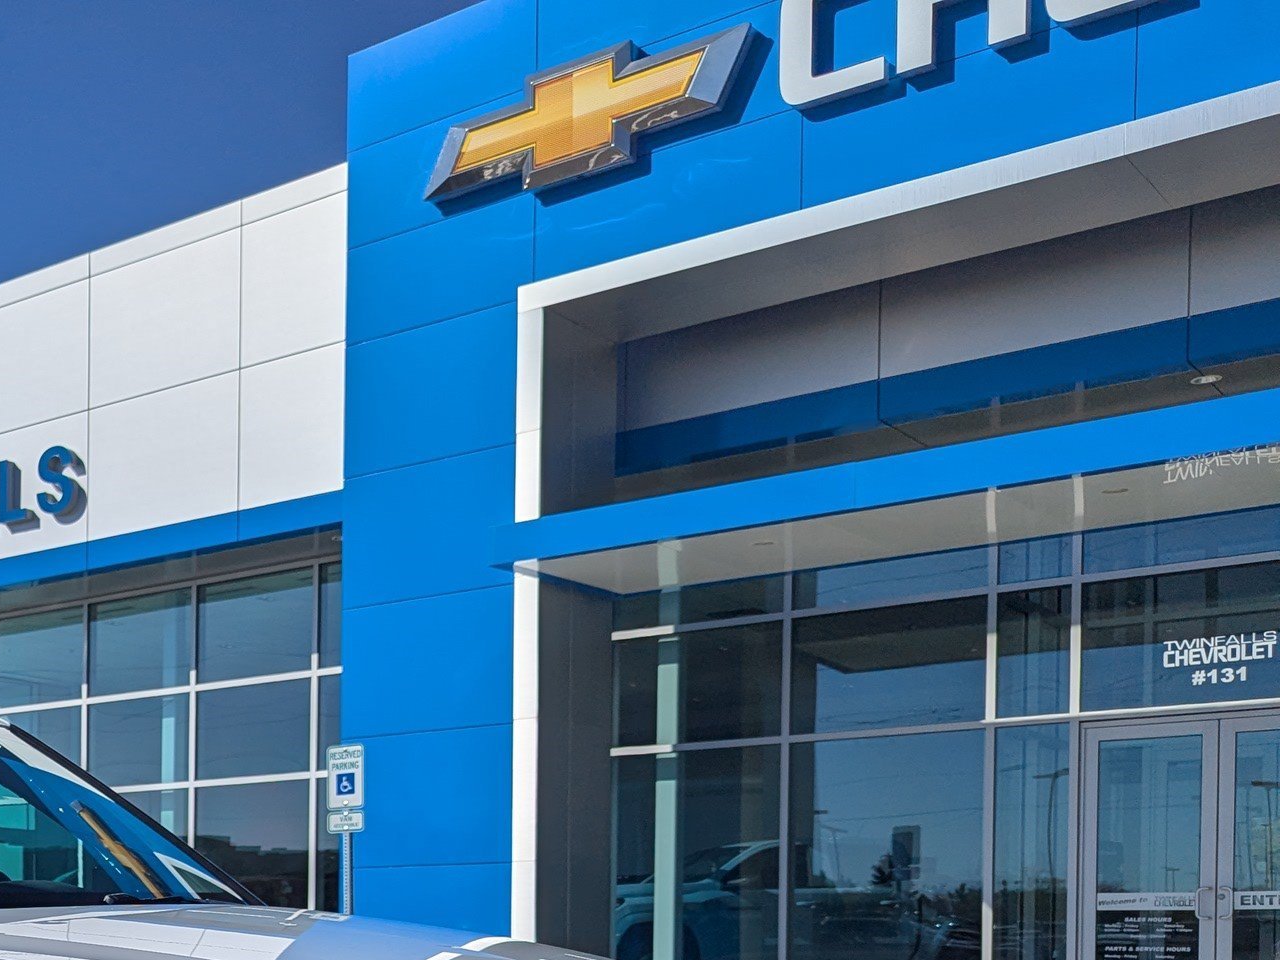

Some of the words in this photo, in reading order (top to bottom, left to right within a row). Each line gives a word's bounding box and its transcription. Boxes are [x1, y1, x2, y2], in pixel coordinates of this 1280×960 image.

[1163, 641, 1277, 668] CHEVROLET
[1191, 666, 1247, 686] #131
[329, 749, 361, 761] RESERVED
[331, 761, 360, 771] PARKING
[1098, 897, 1137, 906] Welcome
[1240, 894, 1280, 906] ENT
